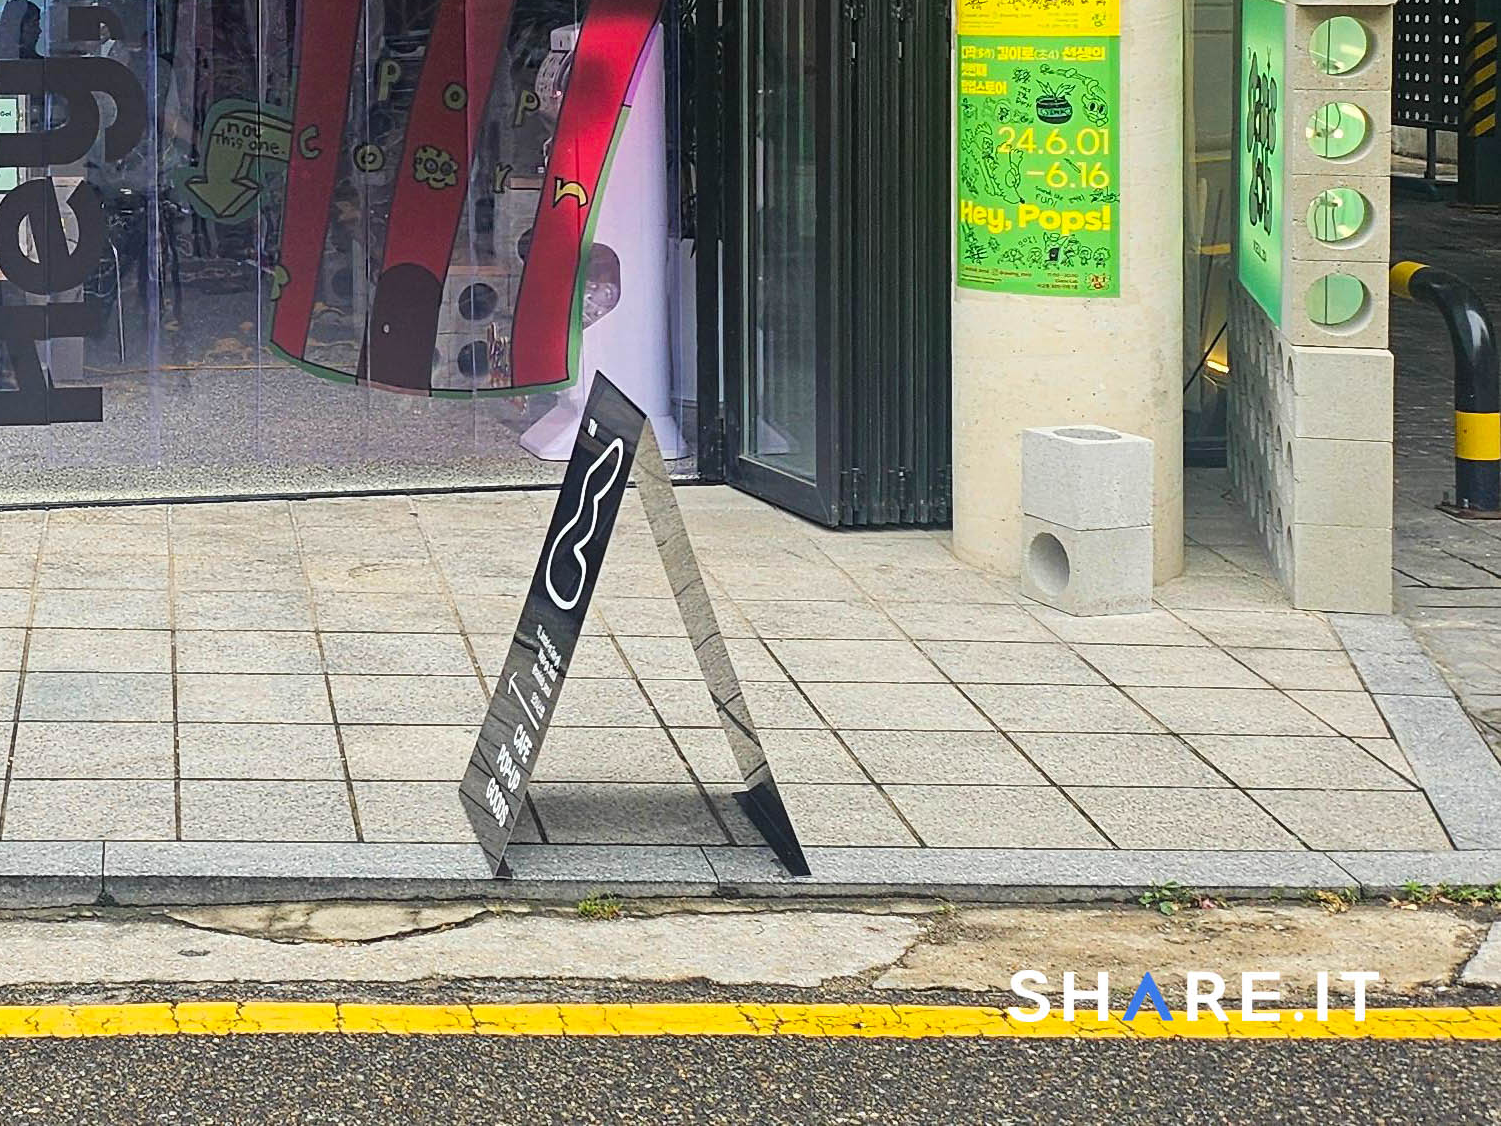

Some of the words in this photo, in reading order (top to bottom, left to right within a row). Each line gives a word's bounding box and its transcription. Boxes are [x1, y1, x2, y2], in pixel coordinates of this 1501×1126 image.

[998, 126, 1110, 156] 24.6.01
[960, 199, 1013, 234] Hey,
[1018, 202, 1111, 235] Pops!
[512, 723, 534, 765] CAFE
[496, 743, 522, 793] POP-UP
[484, 776, 510, 828] GOODS
